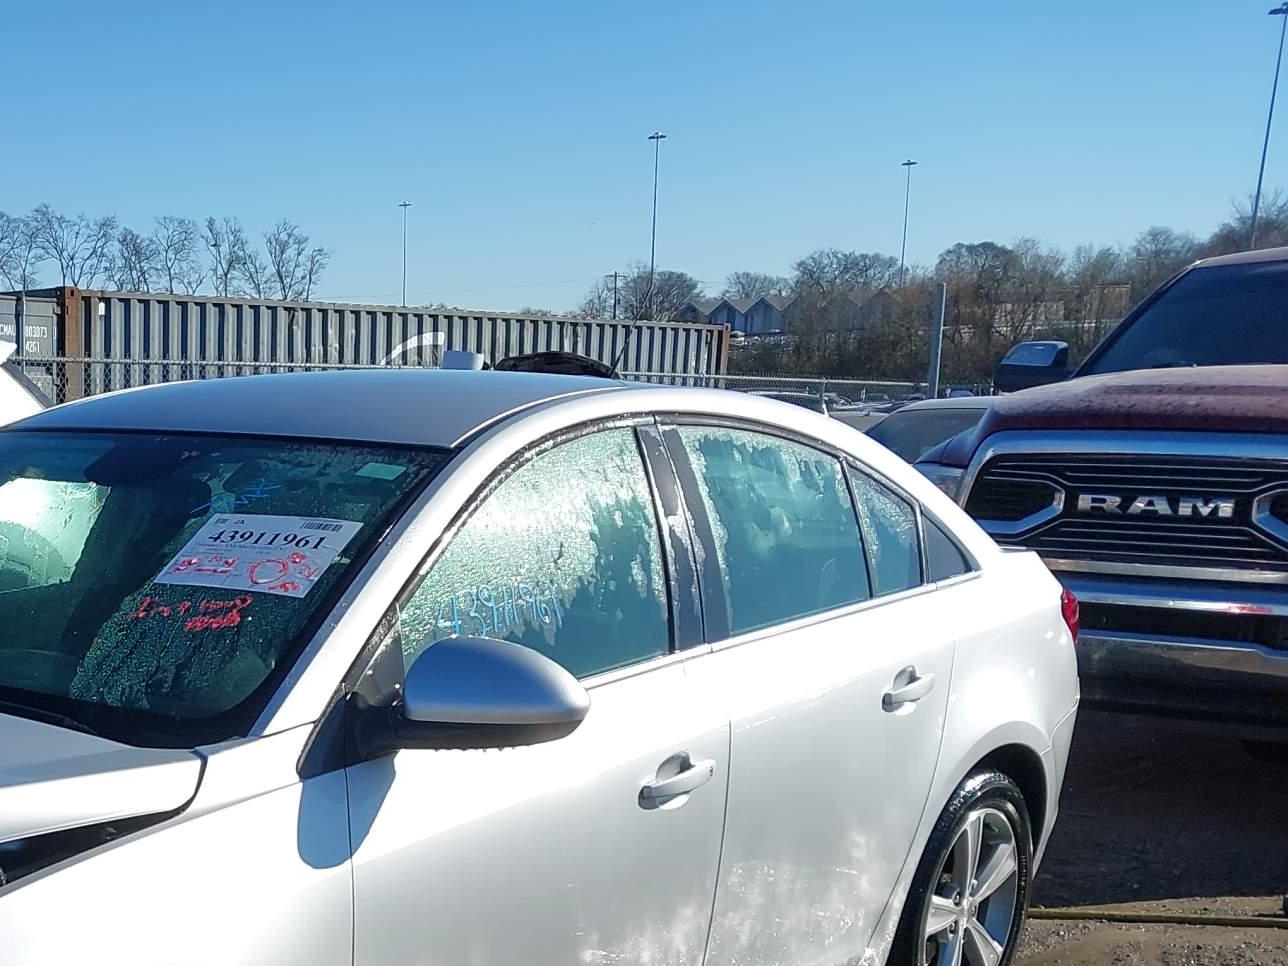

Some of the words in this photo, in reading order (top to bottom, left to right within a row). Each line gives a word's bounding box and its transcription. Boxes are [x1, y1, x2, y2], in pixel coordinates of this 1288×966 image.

[1076, 493, 1237, 518] RAM
[207, 529, 327, 550] 43911961
[436, 584, 563, 637] 43911961
